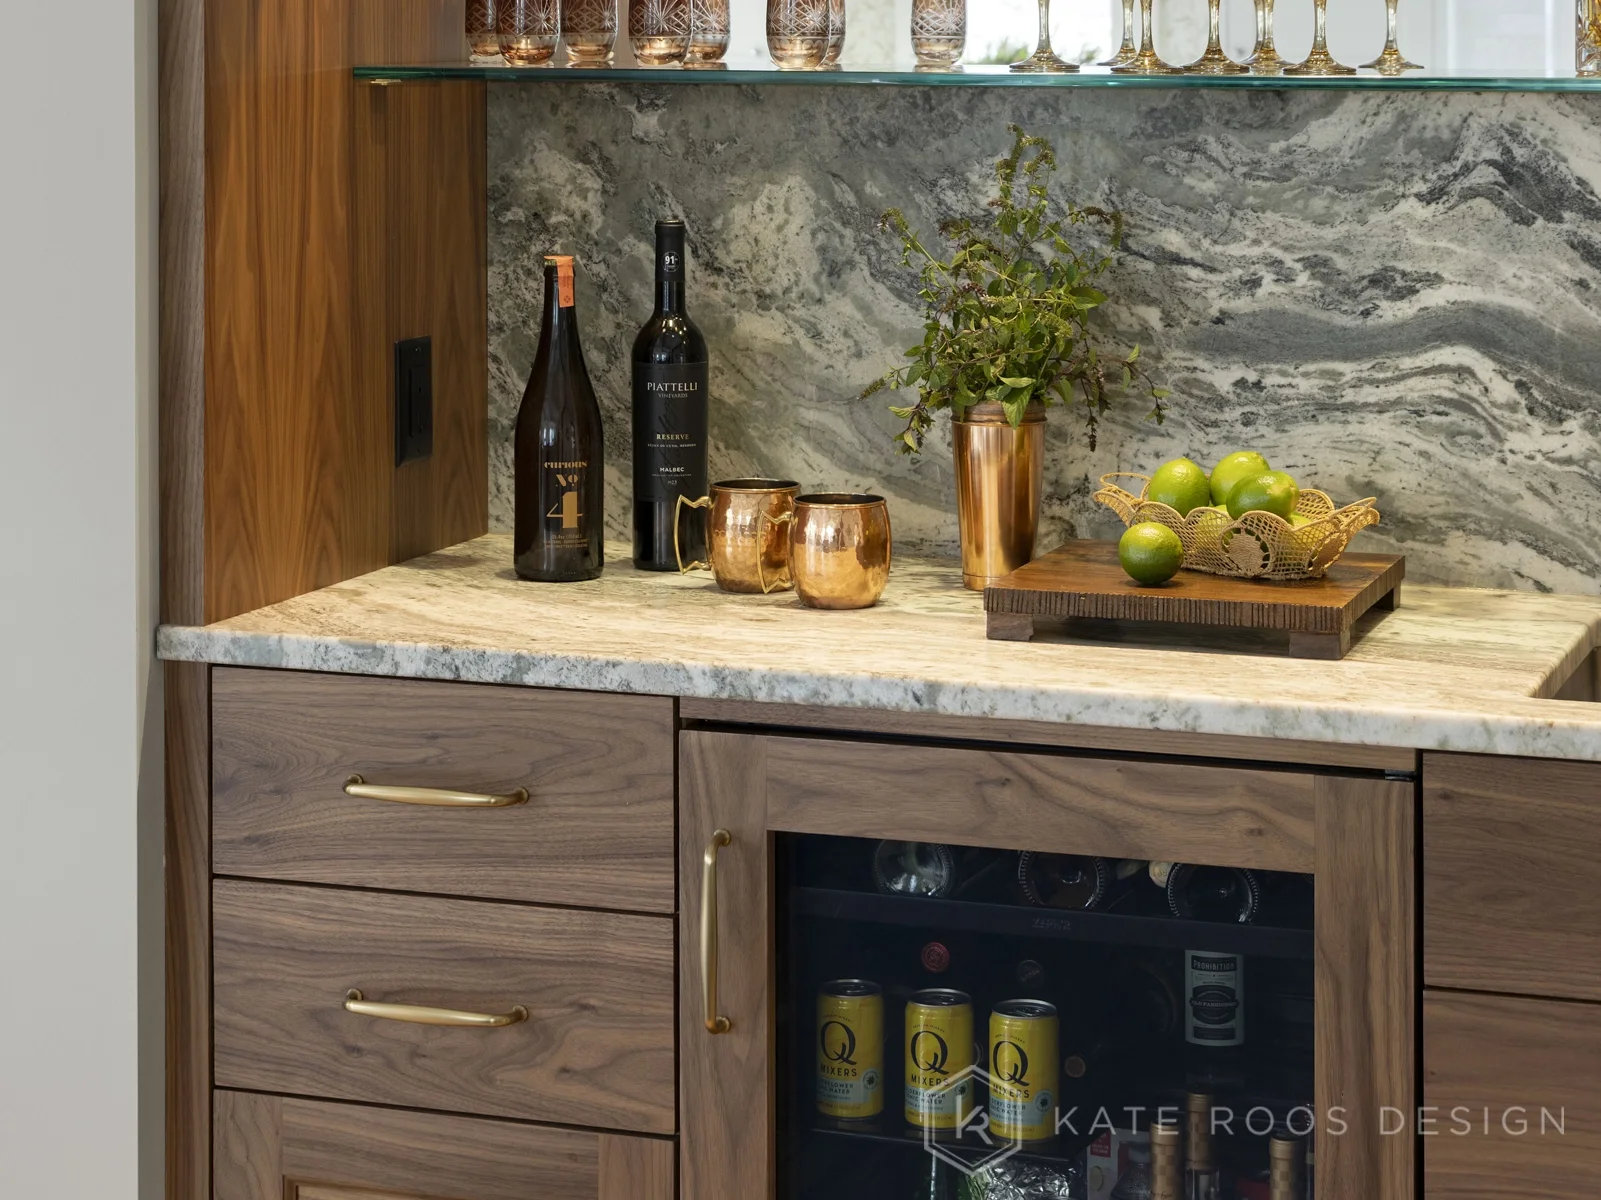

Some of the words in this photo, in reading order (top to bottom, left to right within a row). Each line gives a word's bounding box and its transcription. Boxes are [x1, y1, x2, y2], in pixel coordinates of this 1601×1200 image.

[664, 255, 675, 265] 91
[647, 381, 698, 392] PIATTELLI
[546, 491, 583, 529] 4
[820, 1020, 857, 1066] Q
[910, 1030, 950, 1075] Q
[820, 1062, 857, 1077] MIXERS
[992, 1040, 1030, 1087] Q
[911, 1073, 949, 1087] MIXERS
[992, 1083, 1030, 1098] MIXERS
